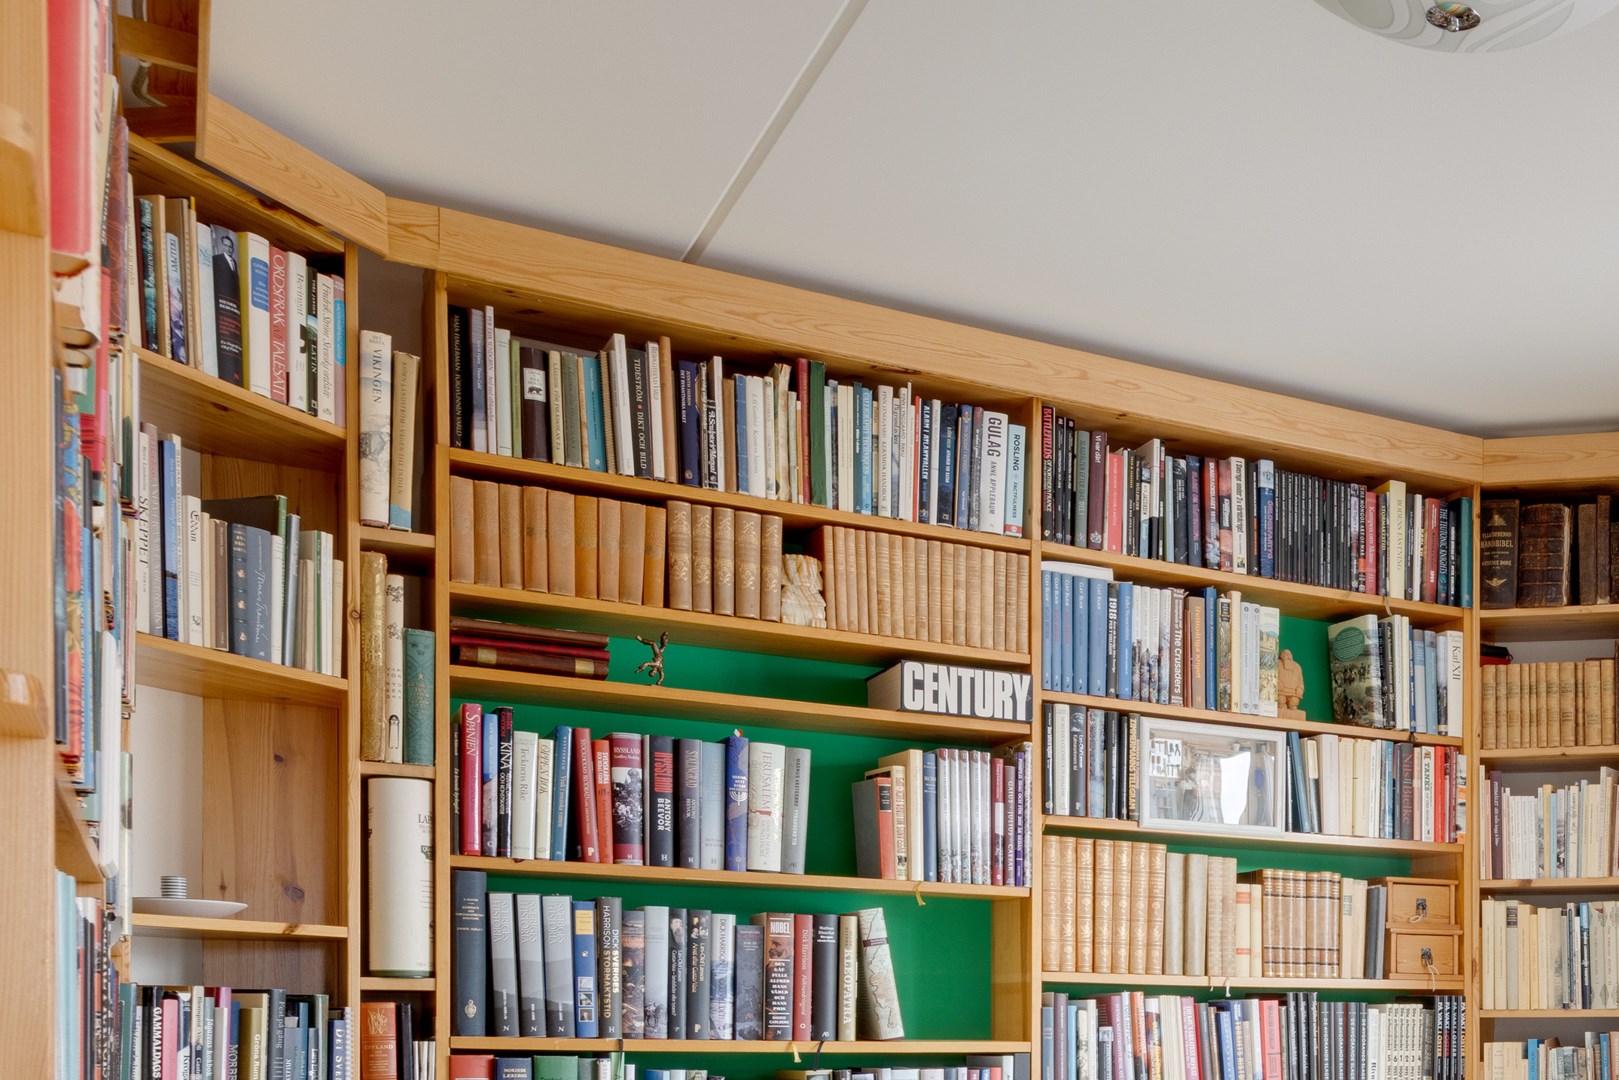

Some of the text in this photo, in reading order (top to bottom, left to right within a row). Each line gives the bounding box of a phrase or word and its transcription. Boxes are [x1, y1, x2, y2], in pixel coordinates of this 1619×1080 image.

[637, 412, 645, 430] DIKT
[986, 417, 1002, 457] GULAG
[638, 432, 646, 449] OCH
[1011, 434, 1021, 471] ROSLING
[639, 451, 647, 469] BILD
[989, 461, 997, 479] ANNE
[1480, 539, 1514, 548] HANDBIBEL
[1109, 597, 1117, 619] 1918
[1173, 629, 1182, 693] The Crusaders
[903, 661, 1031, 721] CENTURY
[1128, 771, 1136, 810] TELEGRAM
[657, 798, 665, 832] BEEVOR
[663, 798, 671, 832] ANTONY
[611, 929, 619, 949] DICK
[602, 905, 611, 1019] HARRISON STORMAKTSTID
[843, 948, 853, 1024] KLEOPATRA
